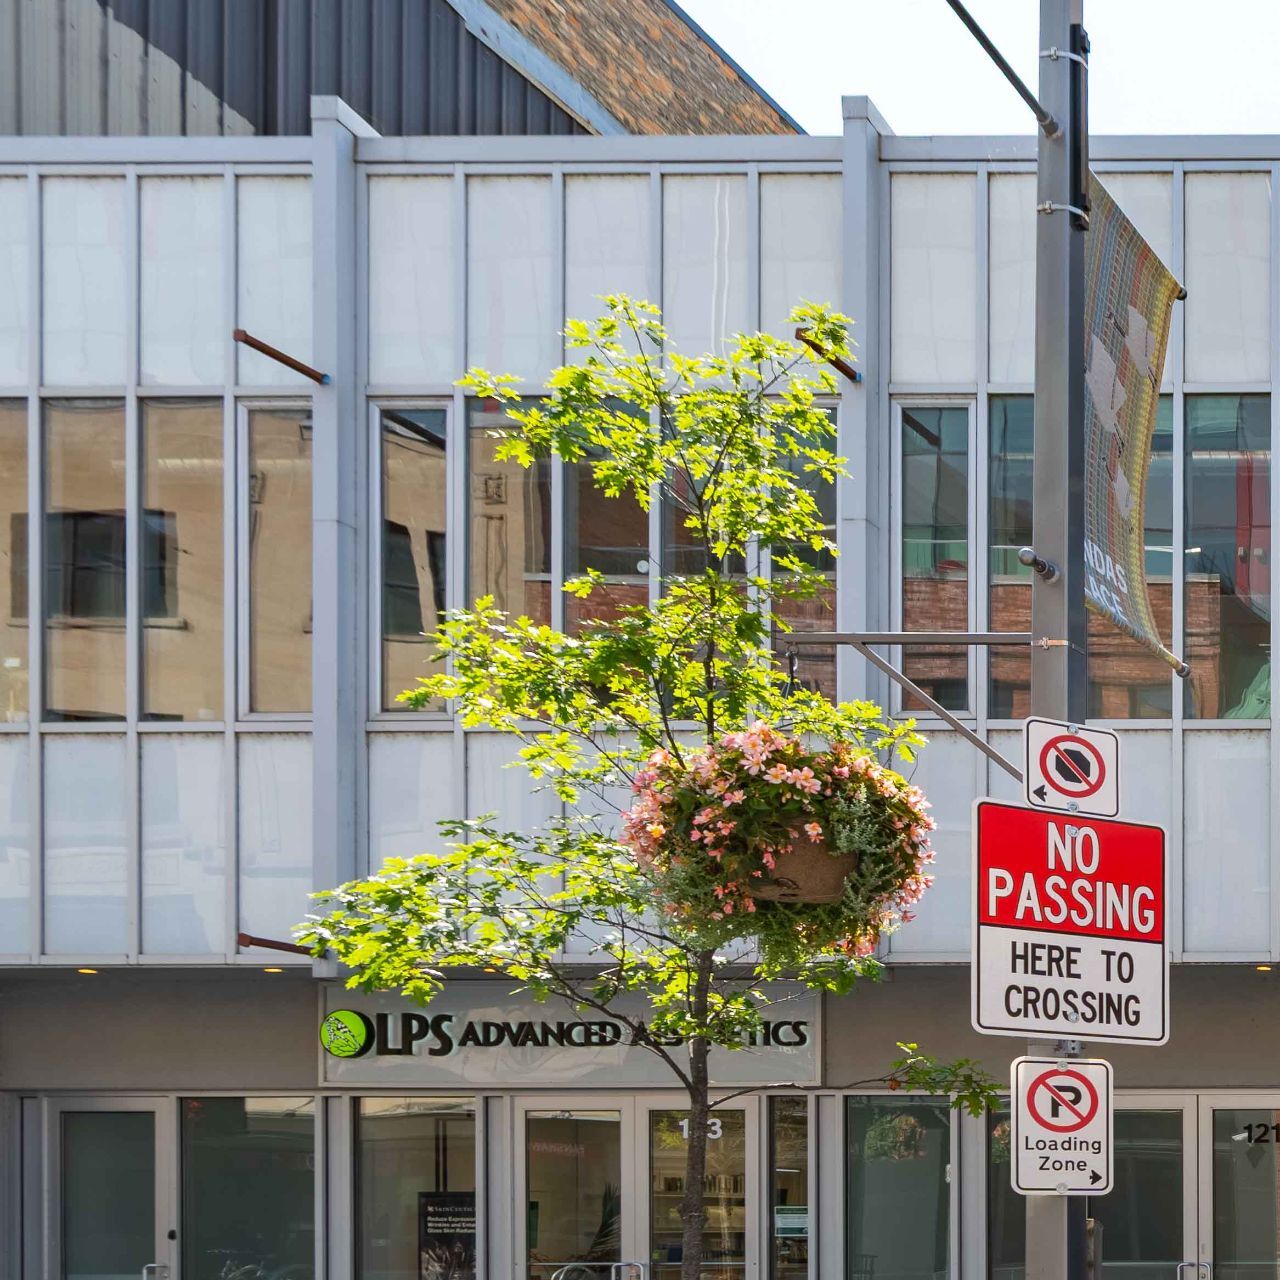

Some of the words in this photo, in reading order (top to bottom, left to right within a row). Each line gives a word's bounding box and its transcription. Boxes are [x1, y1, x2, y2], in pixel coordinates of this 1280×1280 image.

[1084, 538, 1128, 594] NDAS
[1047, 821, 1100, 875] NO
[988, 867, 1155, 934] PASSING
[1011, 941, 1081, 979] HERE
[1101, 949, 1134, 983] TO
[1004, 984, 1140, 1026] CROSSING
[376, 1012, 454, 1058] LPS
[458, 1020, 622, 1048] ADVANCED
[678, 1118, 723, 1139] 13
[1025, 1135, 1102, 1155] Loading
[1243, 1123, 1280, 1143] 121
[1038, 1156, 1087, 1171] Zone
